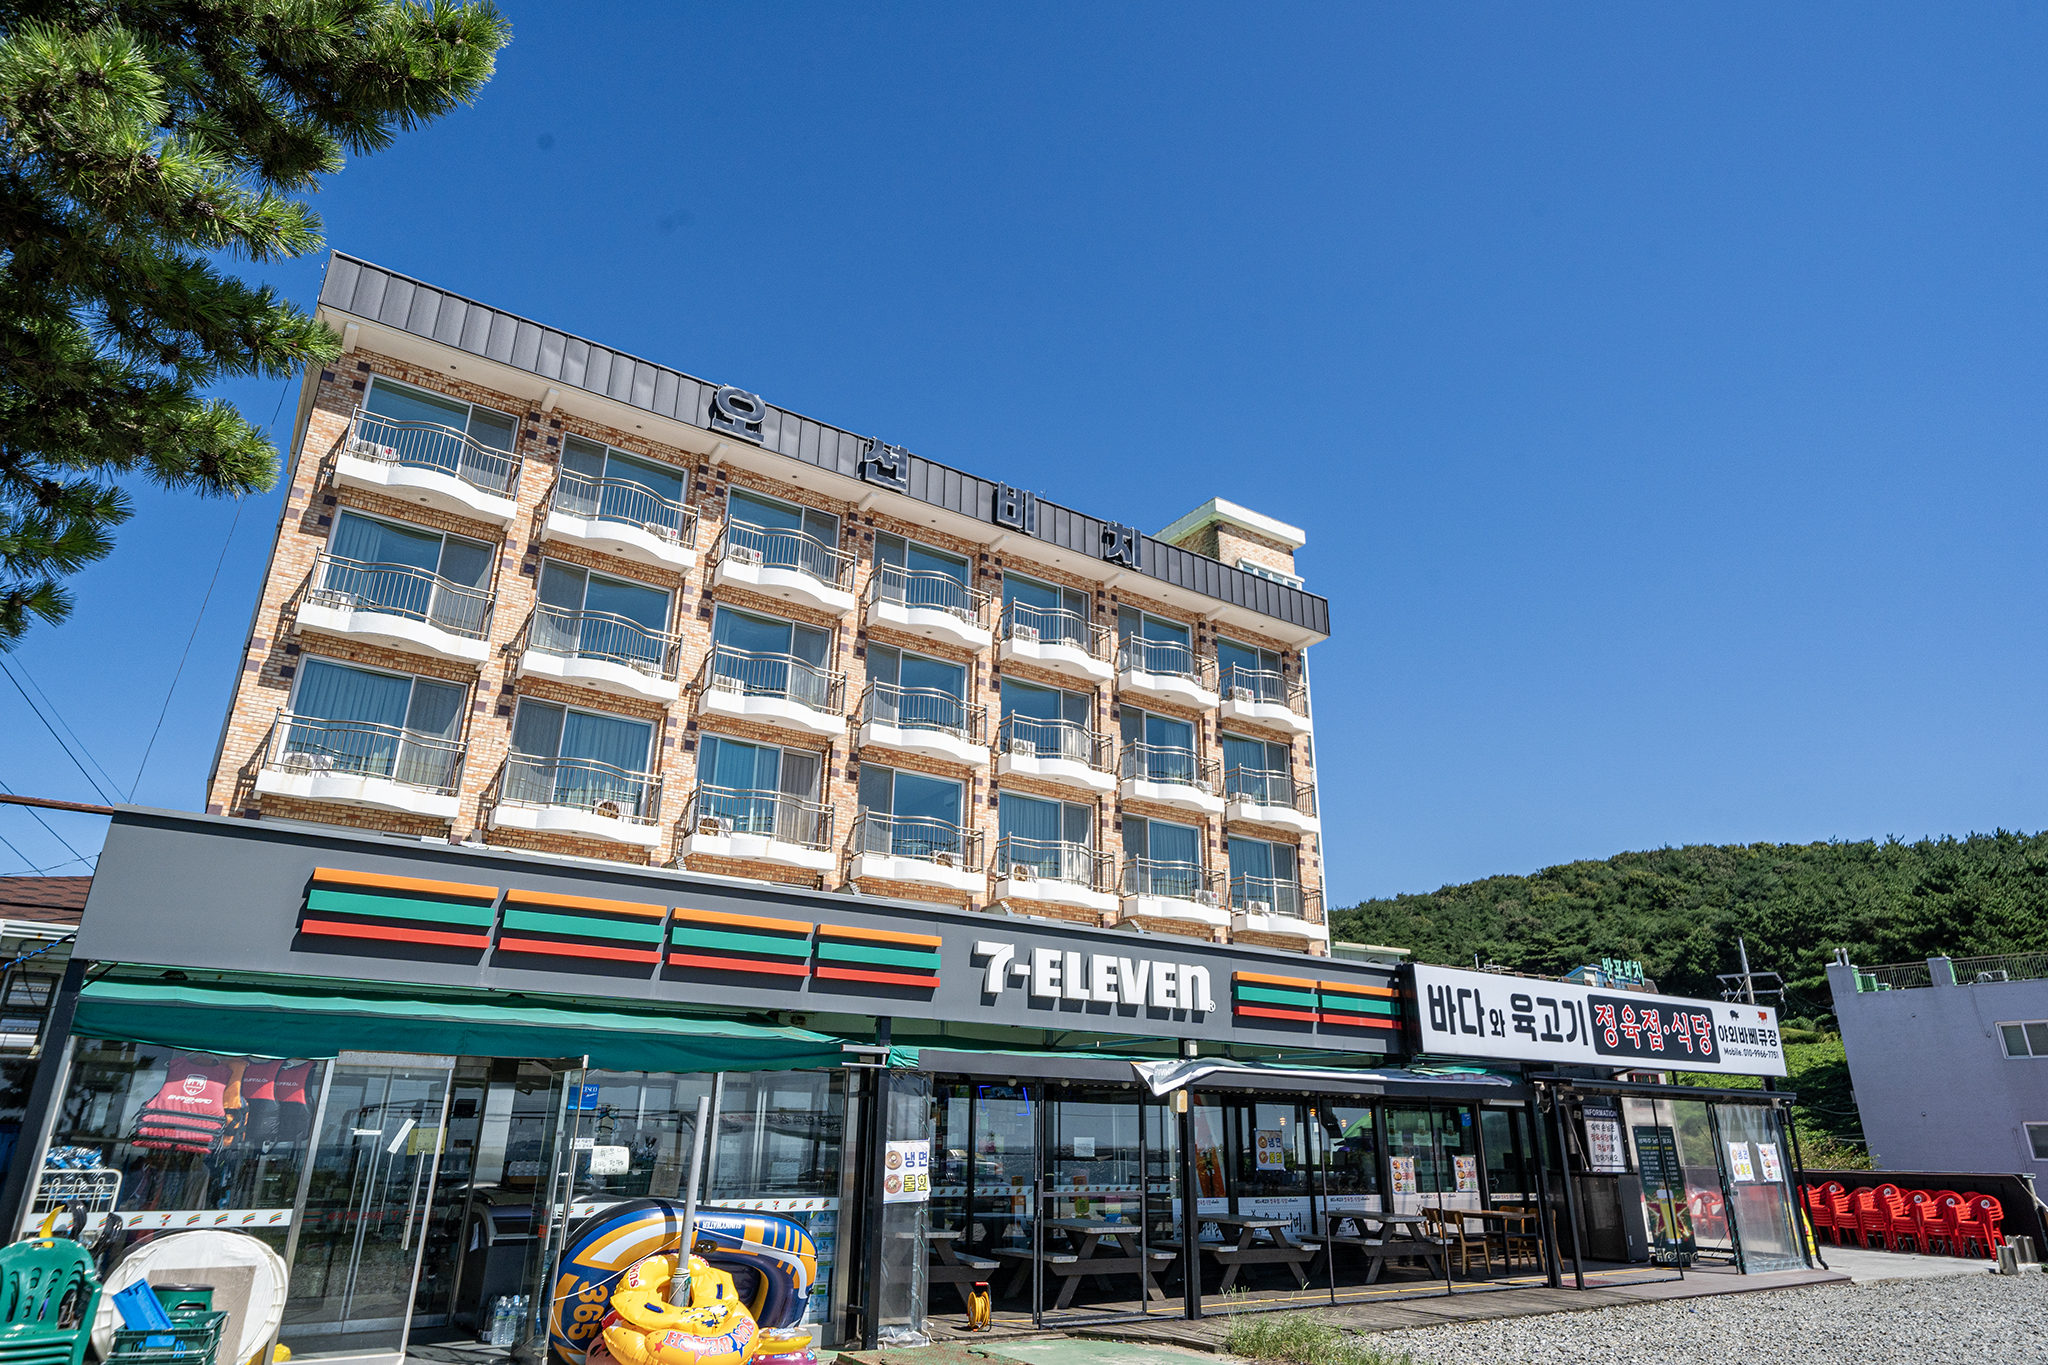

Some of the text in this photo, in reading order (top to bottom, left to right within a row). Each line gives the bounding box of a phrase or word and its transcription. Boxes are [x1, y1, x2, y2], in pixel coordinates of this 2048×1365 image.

[1510, 993, 1588, 1046] 육고기
[1718, 1025, 1778, 1047] 야외바베큐장
[1585, 1108, 1618, 1117] INFORMATION
[904, 1151, 928, 1168] 냉면
[568, 1281, 608, 1341] 365
[663, 1317, 755, 1356] SUN BEACH
